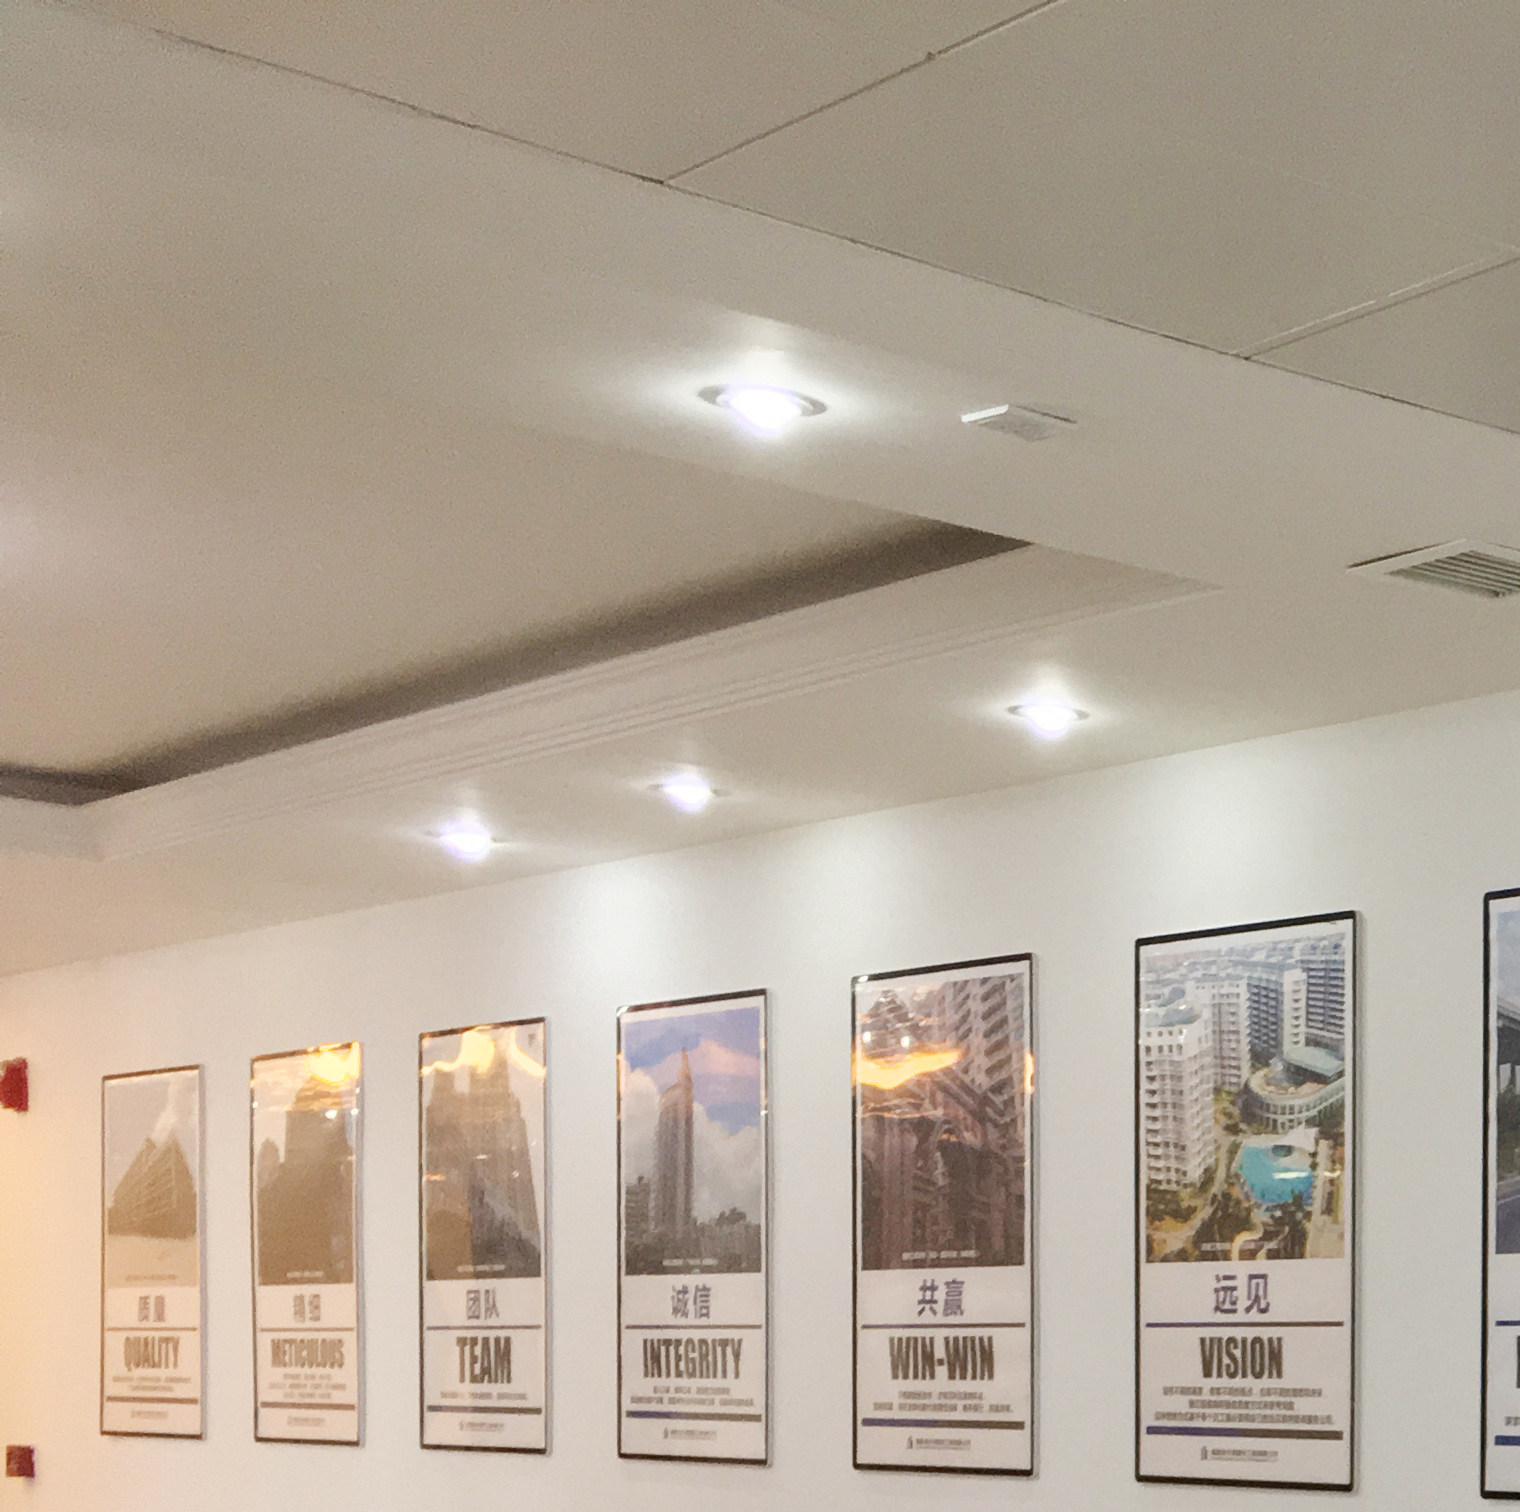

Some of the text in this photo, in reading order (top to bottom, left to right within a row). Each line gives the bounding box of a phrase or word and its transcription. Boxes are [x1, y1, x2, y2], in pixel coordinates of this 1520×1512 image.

[671, 1283, 712, 1319] 诚信
[917, 1278, 965, 1317] 共赢
[1213, 1273, 1271, 1314] 远见
[124, 1336, 180, 1371] QUALITY
[456, 1336, 512, 1384] TEAM
[642, 1337, 743, 1379] INTEGRITY
[889, 1336, 994, 1381] WIN-WIN
[1199, 1336, 1284, 1379] VISION
